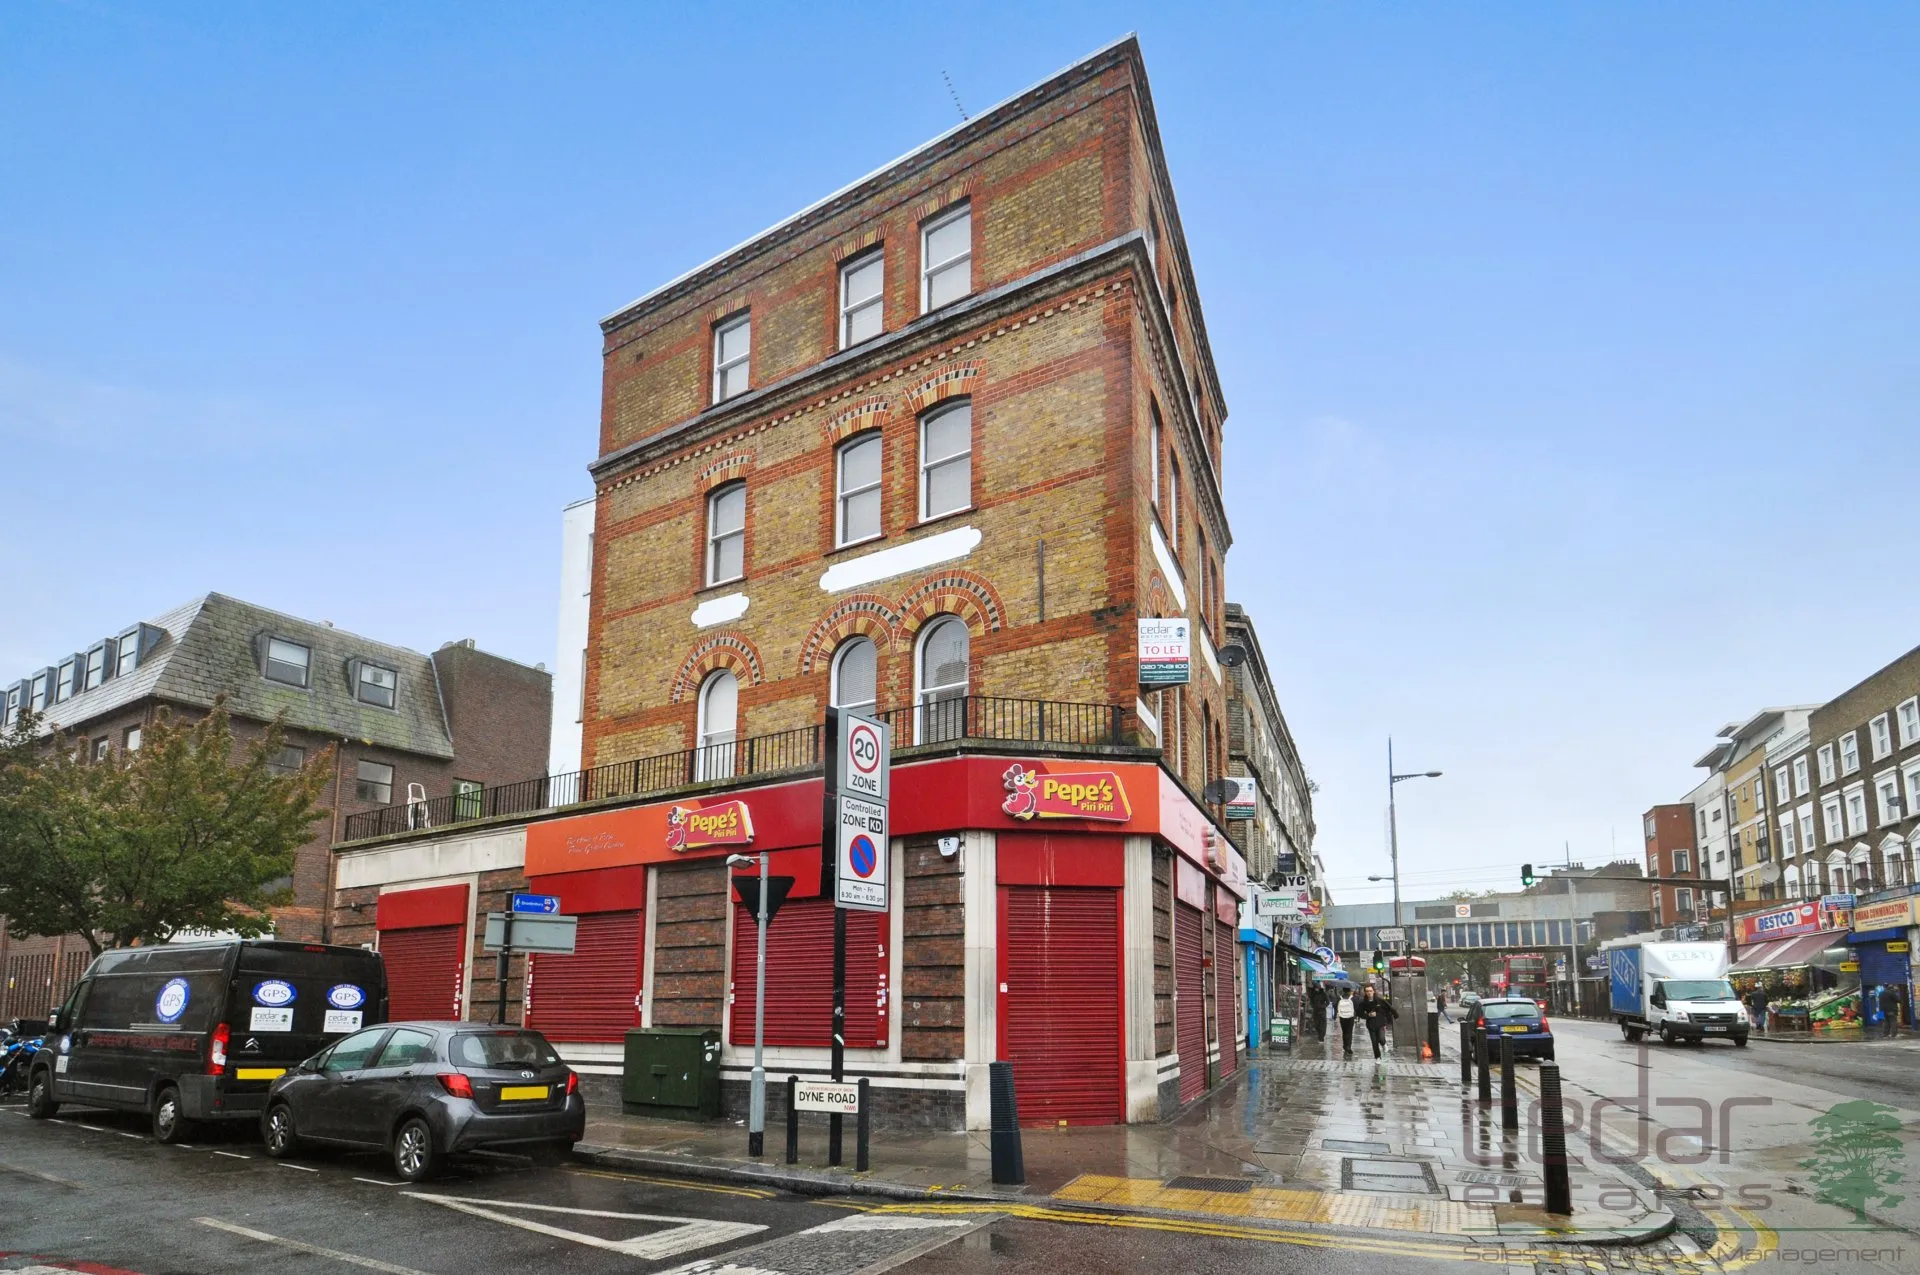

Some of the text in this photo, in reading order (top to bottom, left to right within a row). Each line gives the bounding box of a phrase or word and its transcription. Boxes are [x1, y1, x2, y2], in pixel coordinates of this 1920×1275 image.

[1140, 621, 1172, 634] cedar
[1144, 645, 1183, 654] TO LET
[855, 737, 875, 760] 20
[852, 774, 877, 791] ZONE
[1043, 778, 1114, 806] Pepe's
[846, 800, 881, 816] Controlled
[1081, 802, 1114, 812] Piri Piri
[690, 807, 737, 836] Pepe's
[842, 813, 882, 832] ZONE KD
[713, 829, 737, 838] Piri Piri
[1280, 875, 1305, 887] NYC
[1262, 900, 1294, 909] VAPEHUT
[1758, 911, 1795, 930] BESTCO
[262, 989, 288, 998] GPS
[335, 993, 358, 1001] GPS
[163, 994, 182, 1006] GPS
[255, 1009, 279, 1019] cedar
[328, 1012, 350, 1021] cedar
[1271, 1035, 1289, 1044] FREE
[799, 1091, 856, 1104] DYNE ROAD
